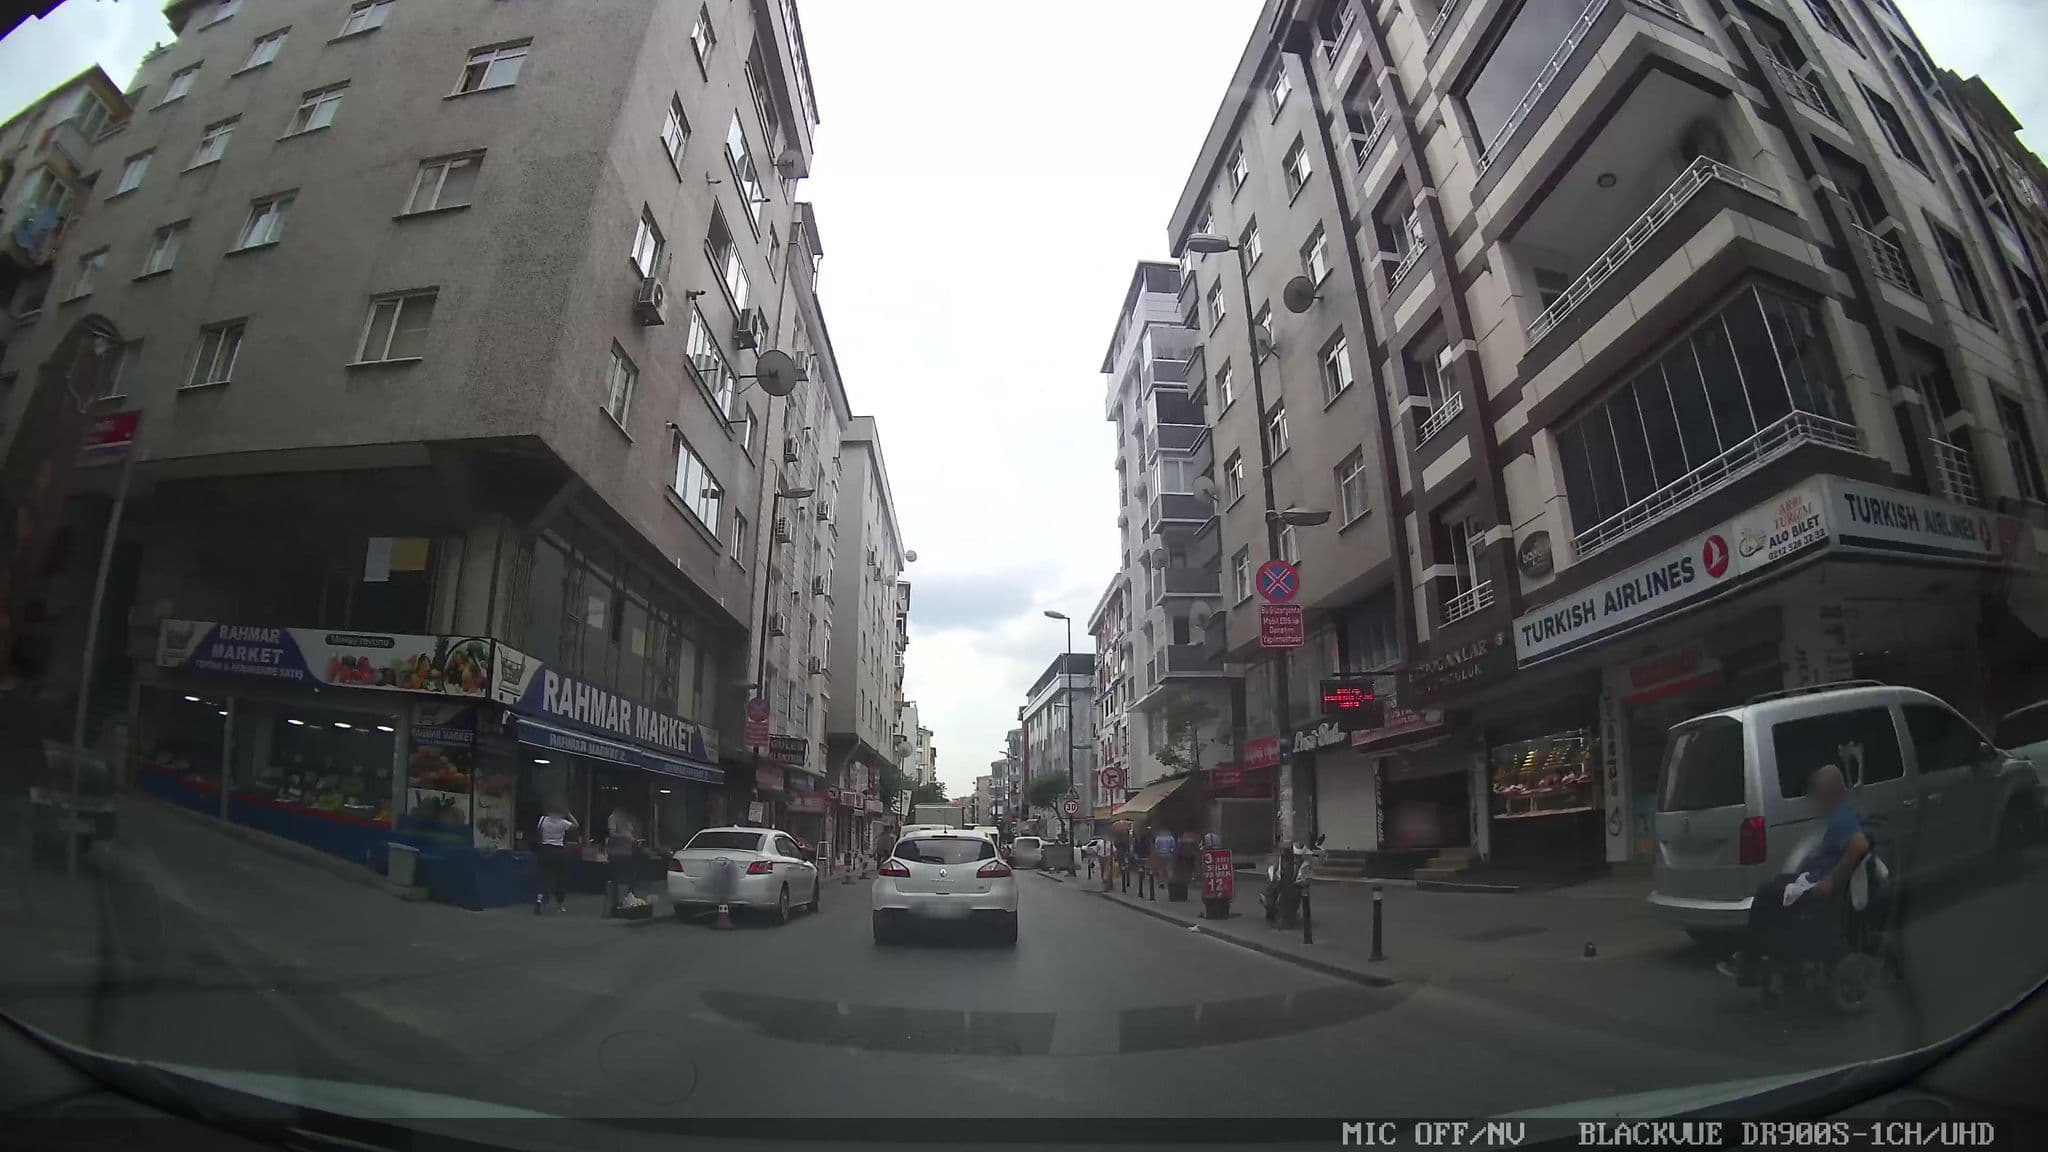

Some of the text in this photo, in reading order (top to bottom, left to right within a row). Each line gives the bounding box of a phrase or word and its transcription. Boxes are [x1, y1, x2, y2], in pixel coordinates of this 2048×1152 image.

[1843, 493, 1977, 541] TURKISH AIRLINES
[1769, 530, 1789, 549] ALO
[1522, 556, 1695, 646] TURKISH AIRLINES
[219, 624, 281, 643] RAHMAR
[210, 642, 284, 664] MARKET
[543, 668, 631, 736] RAHMAR
[635, 703, 695, 754] MARKET
[1066, 803, 1076, 811] 30
